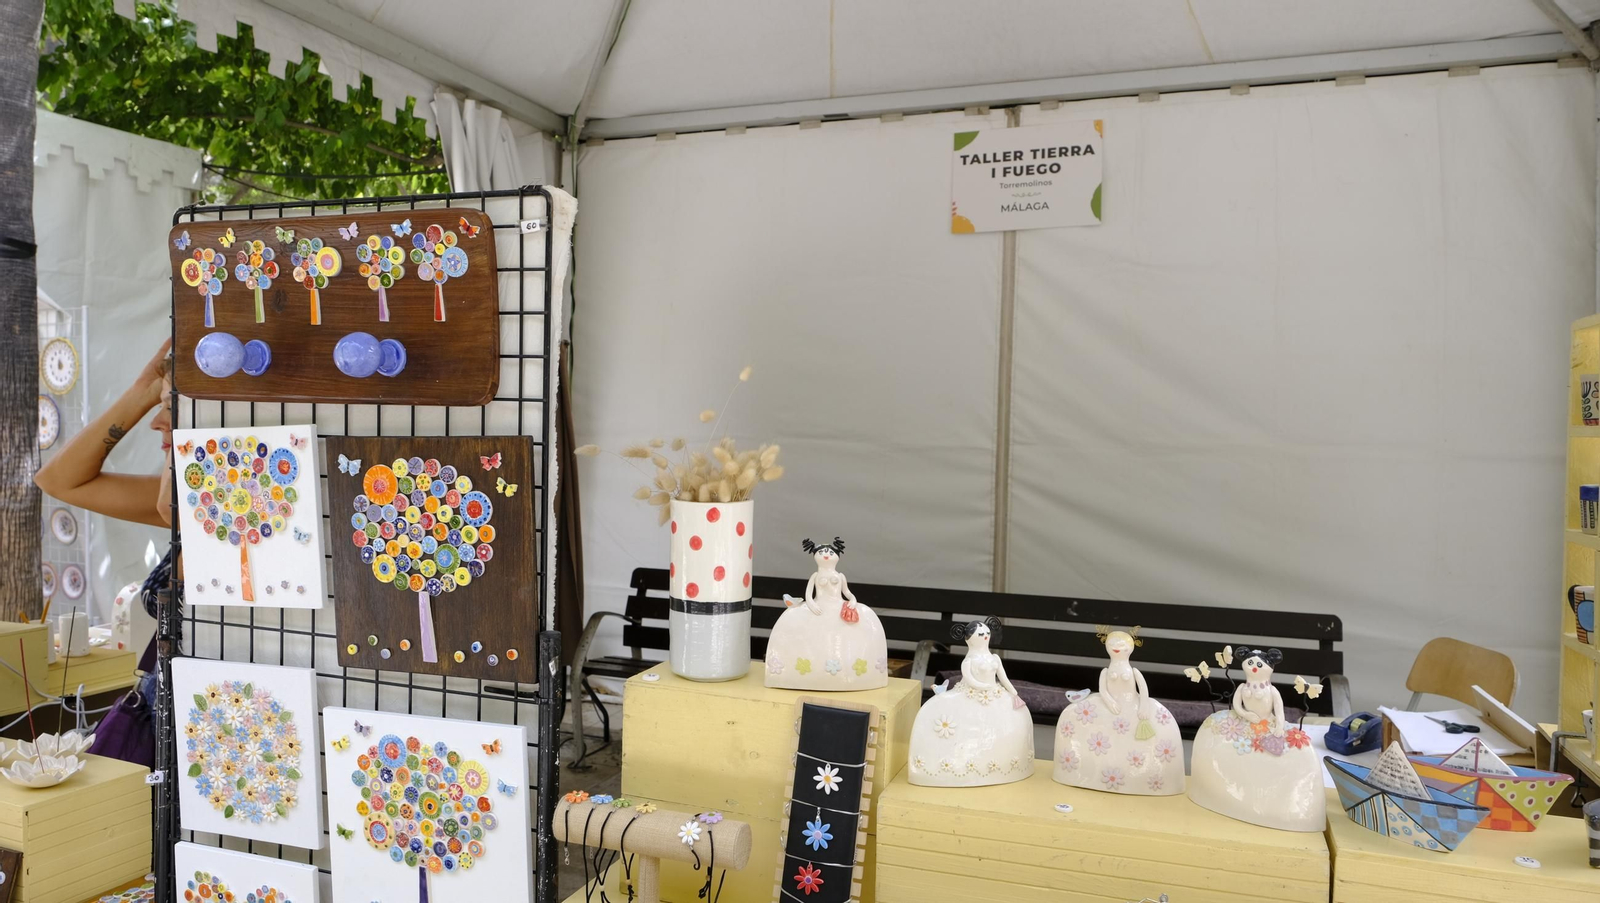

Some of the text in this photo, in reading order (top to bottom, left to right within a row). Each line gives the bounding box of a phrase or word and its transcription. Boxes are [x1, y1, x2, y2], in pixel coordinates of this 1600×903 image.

[960, 144, 1095, 166] TALLER TIERRA
[991, 162, 1061, 178] I FUEGO
[999, 179, 1053, 189] Torremolinos
[1000, 201, 1050, 213] MÁLAGA
[526, 222, 536, 230] 60
